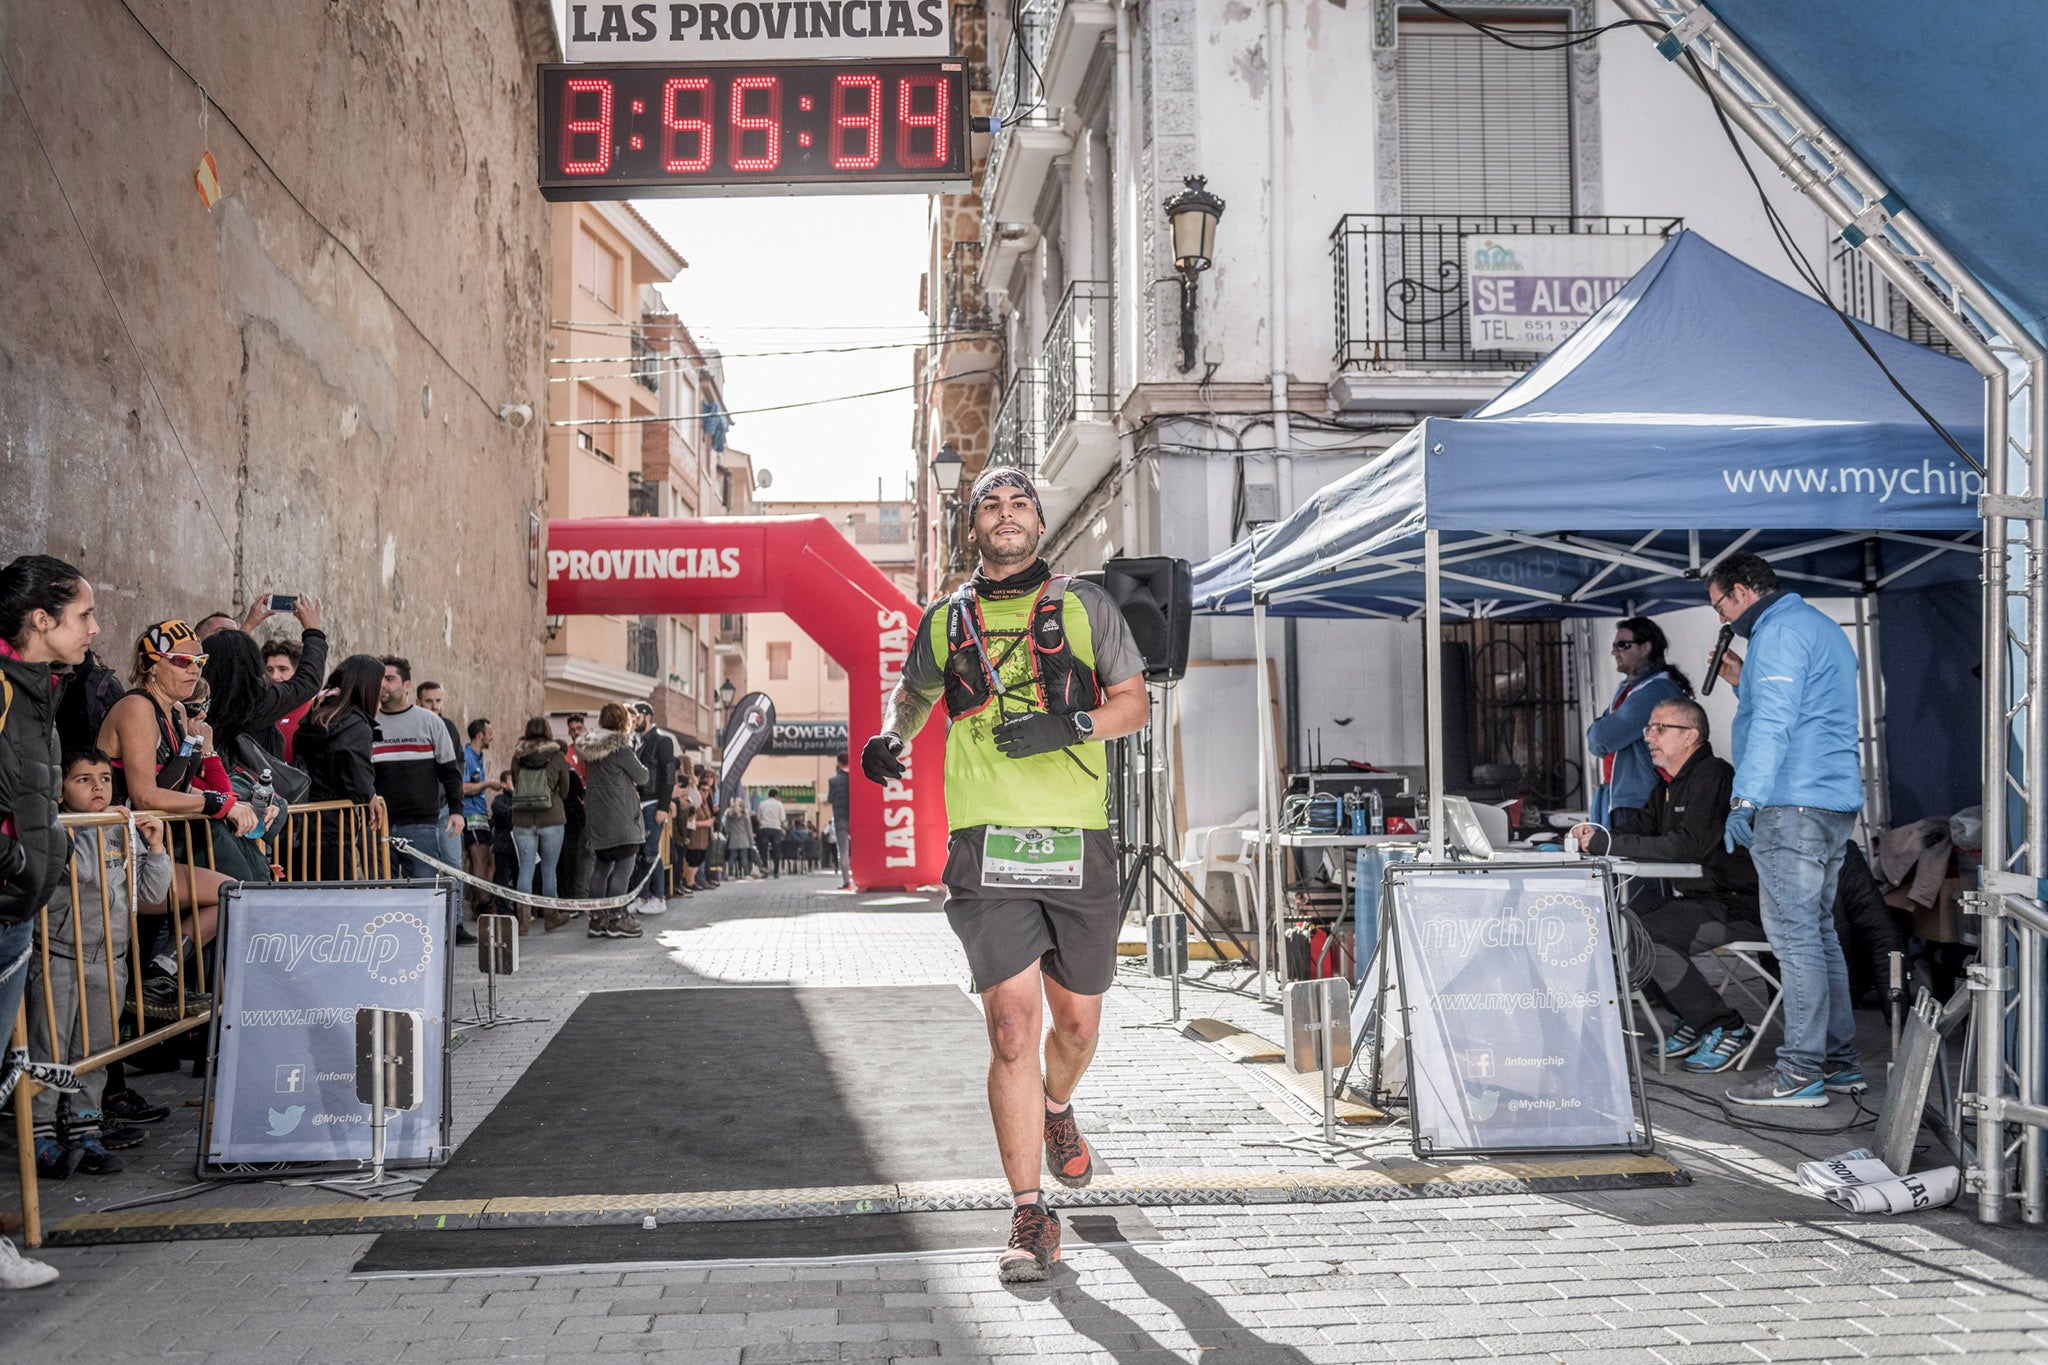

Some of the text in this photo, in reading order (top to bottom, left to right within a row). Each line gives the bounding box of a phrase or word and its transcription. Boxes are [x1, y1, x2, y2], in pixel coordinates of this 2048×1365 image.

[572, 0, 944, 42] LAS PROVINCIAS
[564, 75, 950, 174] 3:55:34
[1478, 279, 1627, 315] SE ALQU
[1524, 320, 1552, 331] 651
[1560, 320, 1584, 331] 93
[1525, 333, 1554, 342] 964
[1723, 458, 1984, 504] www.mychip
[547, 547, 740, 581] PROVINCIAS
[772, 724, 849, 740] POWERA
[772, 738, 803, 749] bebida
[804, 740, 824, 751] para
[884, 807, 917, 868] LAS
[1014, 837, 1055, 855] 718
[1421, 906, 1566, 958] mychip
[246, 923, 400, 973] mychip
[1425, 988, 1601, 1015] www.mychip.es
[1504, 1055, 1565, 1068] /infomychip
[315, 1071, 356, 1082] /infomy
[1508, 1098, 1582, 1112] @Mychip_Info
[1901, 1176, 1930, 1208] LAS
